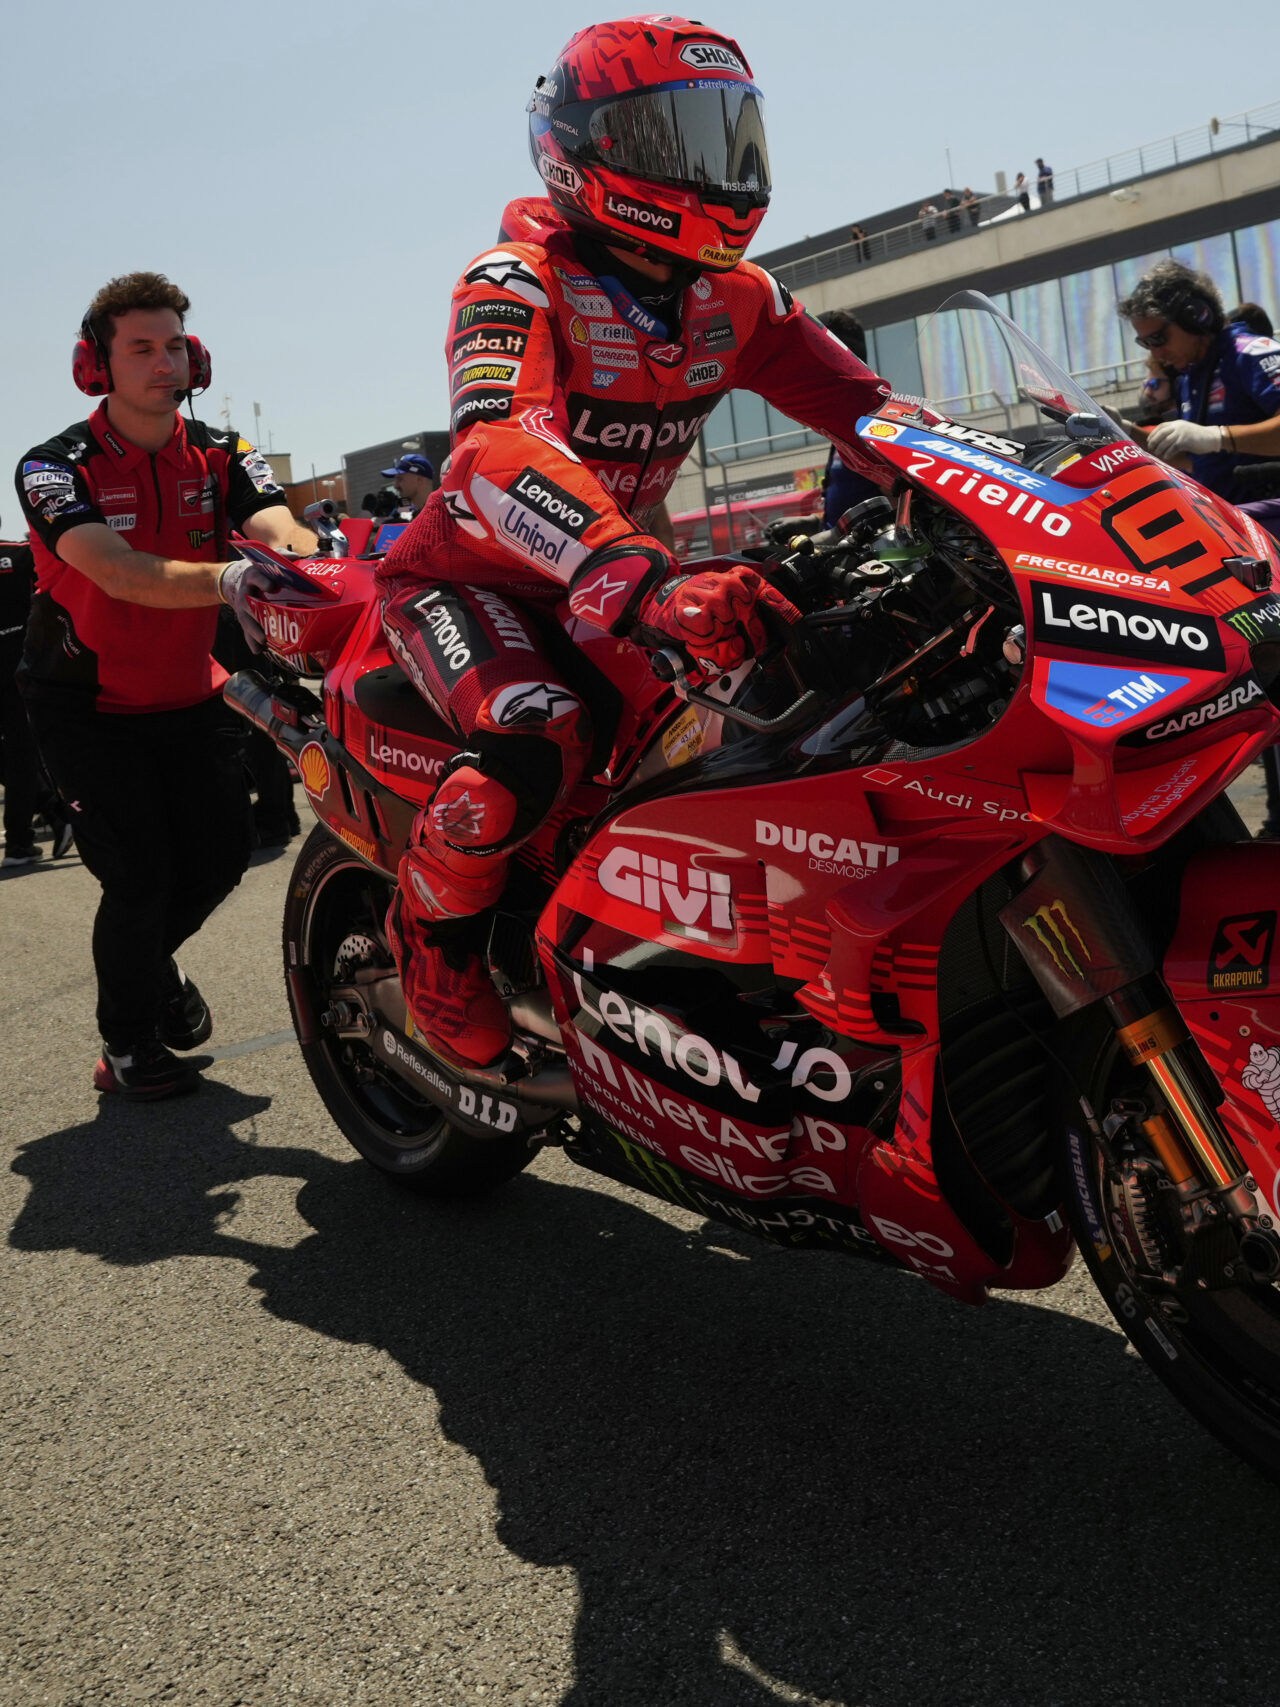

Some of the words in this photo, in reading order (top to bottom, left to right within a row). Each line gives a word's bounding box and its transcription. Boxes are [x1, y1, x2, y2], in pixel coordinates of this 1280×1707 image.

[695, 47, 740, 70] SHOEI
[553, 118, 579, 136] VERTICAL
[543, 157, 575, 189] SHOEI
[721, 179, 760, 192] Insta360
[607, 196, 673, 230] Lenovo
[602, 326, 636, 341] riello
[628, 305, 656, 332] TIM
[705, 328, 730, 340] Lenovo
[453, 332, 524, 363] aruba.it
[592, 349, 638, 363] CARRERA
[687, 364, 718, 384] SHOEI
[105, 432, 124, 456] Lenovo
[572, 408, 709, 450] Lenovo
[929, 422, 1026, 457] WRS
[911, 440, 1047, 490] ADVANCE
[109, 516, 135, 528] riello
[516, 475, 584, 528] Lenovo
[936, 467, 1072, 537] riello
[504, 505, 568, 565] Unipol
[1015, 554, 1171, 592] FRECCIAROSSA
[264, 610, 299, 644] iello
[414, 590, 471, 671] Lenovo
[1042, 592, 1209, 651] Lenovo
[1107, 674, 1166, 710] TIM
[1146, 680, 1264, 740] CARRERA
[370, 736, 444, 777] Lenovo
[1155, 759, 1198, 793] Ducati
[903, 780, 973, 810] Audi
[982, 800, 1035, 822] Spo
[1144, 775, 1198, 818] Mugello
[755, 819, 899, 868] DUCATI
[597, 845, 733, 930] GIVI
[573, 947, 852, 1103] Lenovo
[397, 1043, 453, 1099] Reflexallen
[458, 1084, 518, 1133] D.I.D
[566, 1056, 656, 1129] streparava
[622, 1062, 848, 1164] NetApp
[584, 1092, 667, 1157] SIEMENS
[679, 1144, 838, 1195] elica
[1068, 1133, 1099, 1226] MICHELIN
